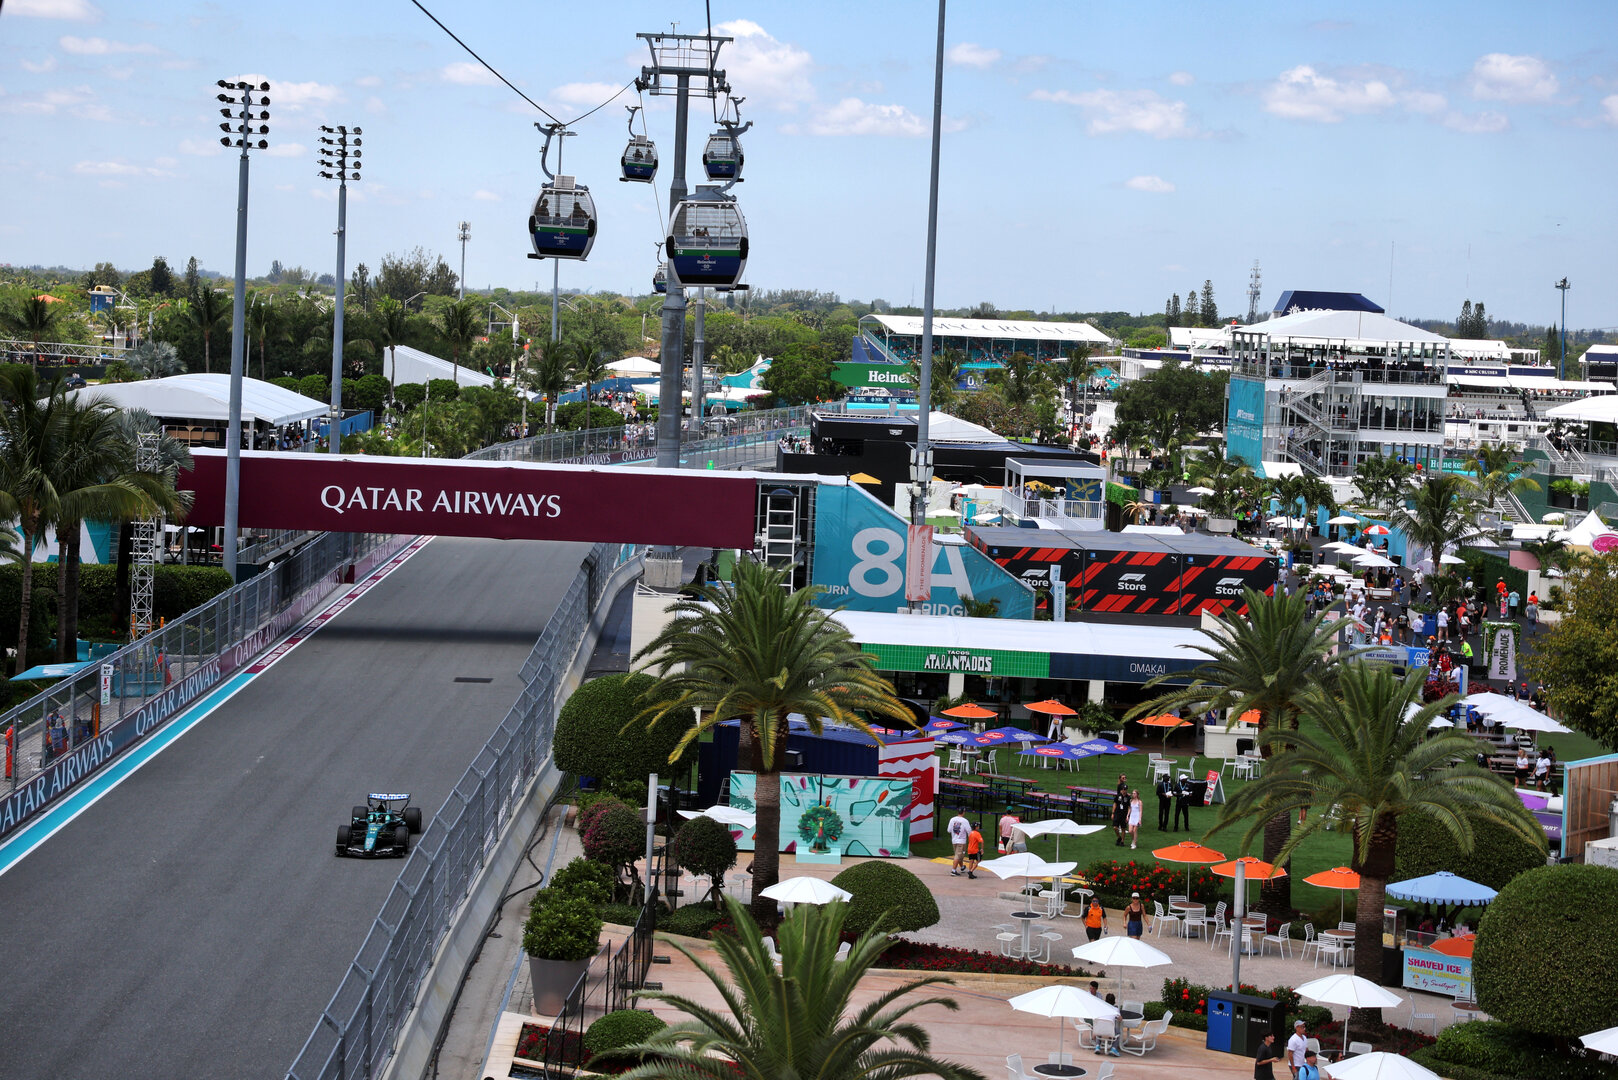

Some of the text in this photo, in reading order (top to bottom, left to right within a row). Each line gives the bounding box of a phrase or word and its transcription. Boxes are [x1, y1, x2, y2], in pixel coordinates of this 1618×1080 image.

[868, 370, 920, 384] Heinek
[622, 449, 645, 462] QATAR
[1430, 460, 1464, 470] Hneke
[320, 485, 562, 518] QATAR AIRWAYS
[1118, 582, 1146, 591] Store
[1216, 586, 1244, 595] Store
[922, 603, 968, 617] RIDG
[234, 628, 263, 667] QATAR
[1499, 634, 1510, 675] PROMENADE
[924, 654, 992, 672] ATARANTADOS
[1130, 663, 1166, 674] OMAKAI
[136, 658, 221, 736] QATAR AIRWAYS
[50, 731, 113, 798] AIRWAYS
[1408, 957, 1444, 970] SHAVED
[1446, 964, 1462, 974] ICE
[1422, 978, 1428, 987] by
